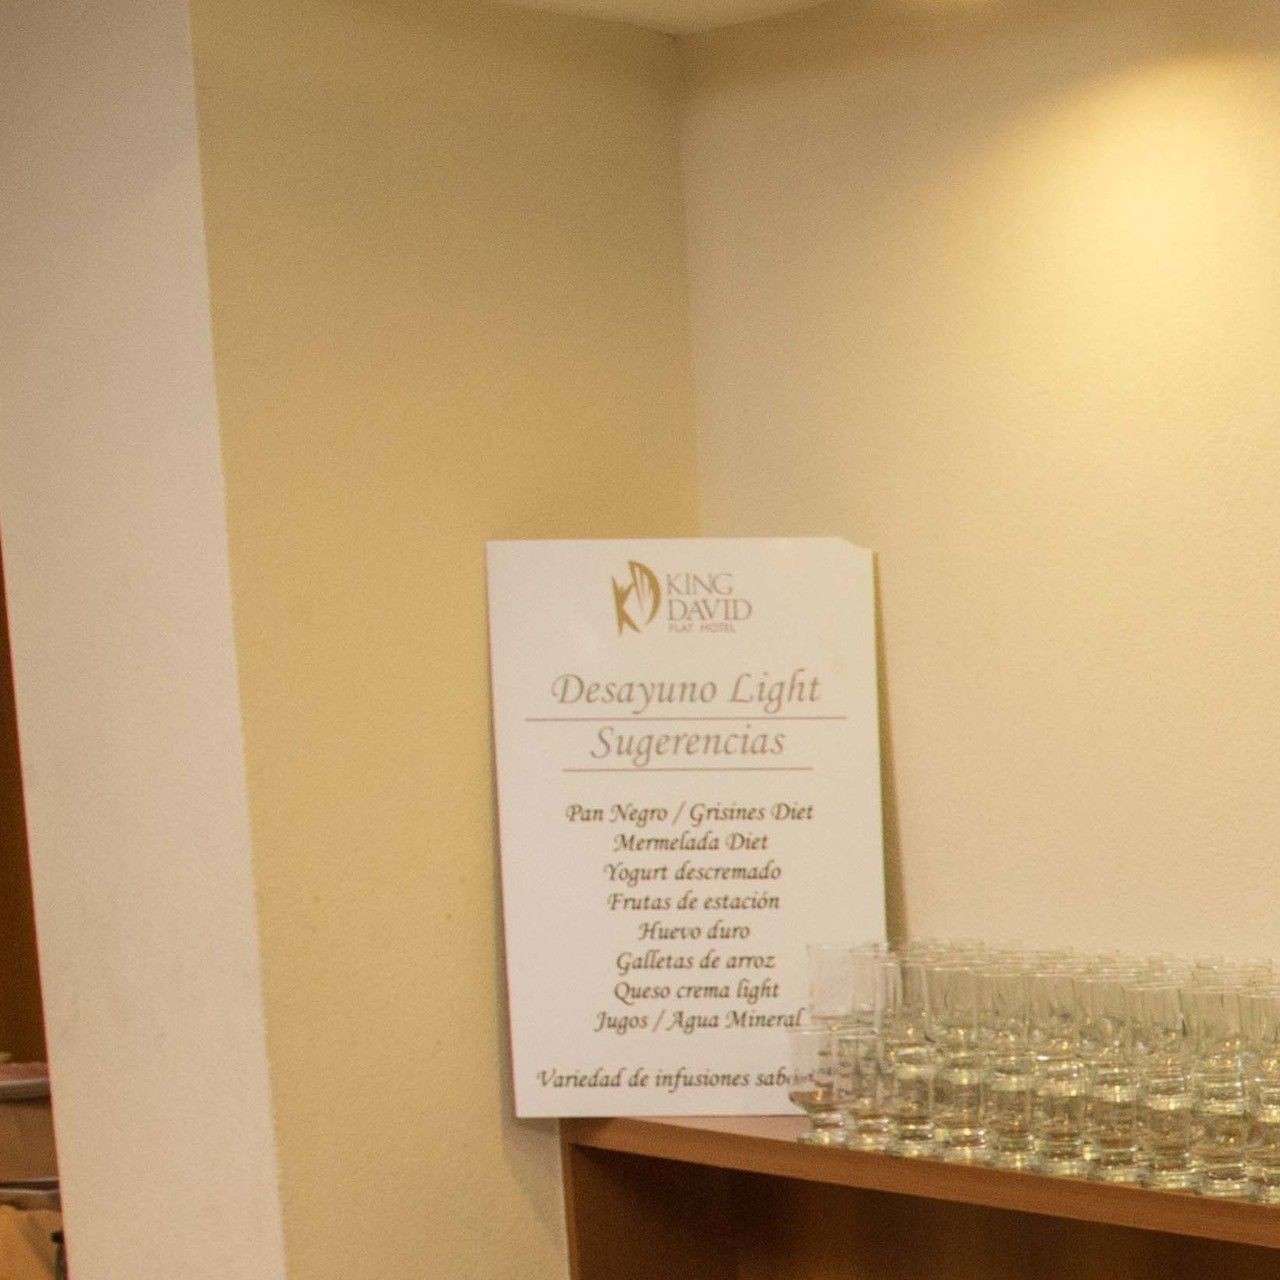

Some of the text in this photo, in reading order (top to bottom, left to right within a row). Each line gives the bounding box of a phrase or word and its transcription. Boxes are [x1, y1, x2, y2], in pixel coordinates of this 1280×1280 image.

[666, 573, 733, 595] KING
[667, 598, 753, 622] DAVID
[700, 622, 734, 633] HOTEL
[552, 668, 819, 714] Desayuno Light
[590, 724, 786, 766] Sugerencias
[565, 802, 814, 828] Pan Negro / Grisines Diet
[614, 830, 768, 852] Mermelada Diet
[604, 859, 782, 888] Yogurt descremado
[607, 889, 780, 911] Frutas de estación
[638, 919, 751, 941] Huevo duro
[615, 948, 775, 975] Galletas de arroz
[613, 977, 780, 1006] Queso crema light
[594, 1007, 803, 1036] Jugos / Agua Mineral
[537, 1067, 625, 1089] Variedad
[627, 1067, 650, 1088] de
[655, 1066, 750, 1094] infusiones
